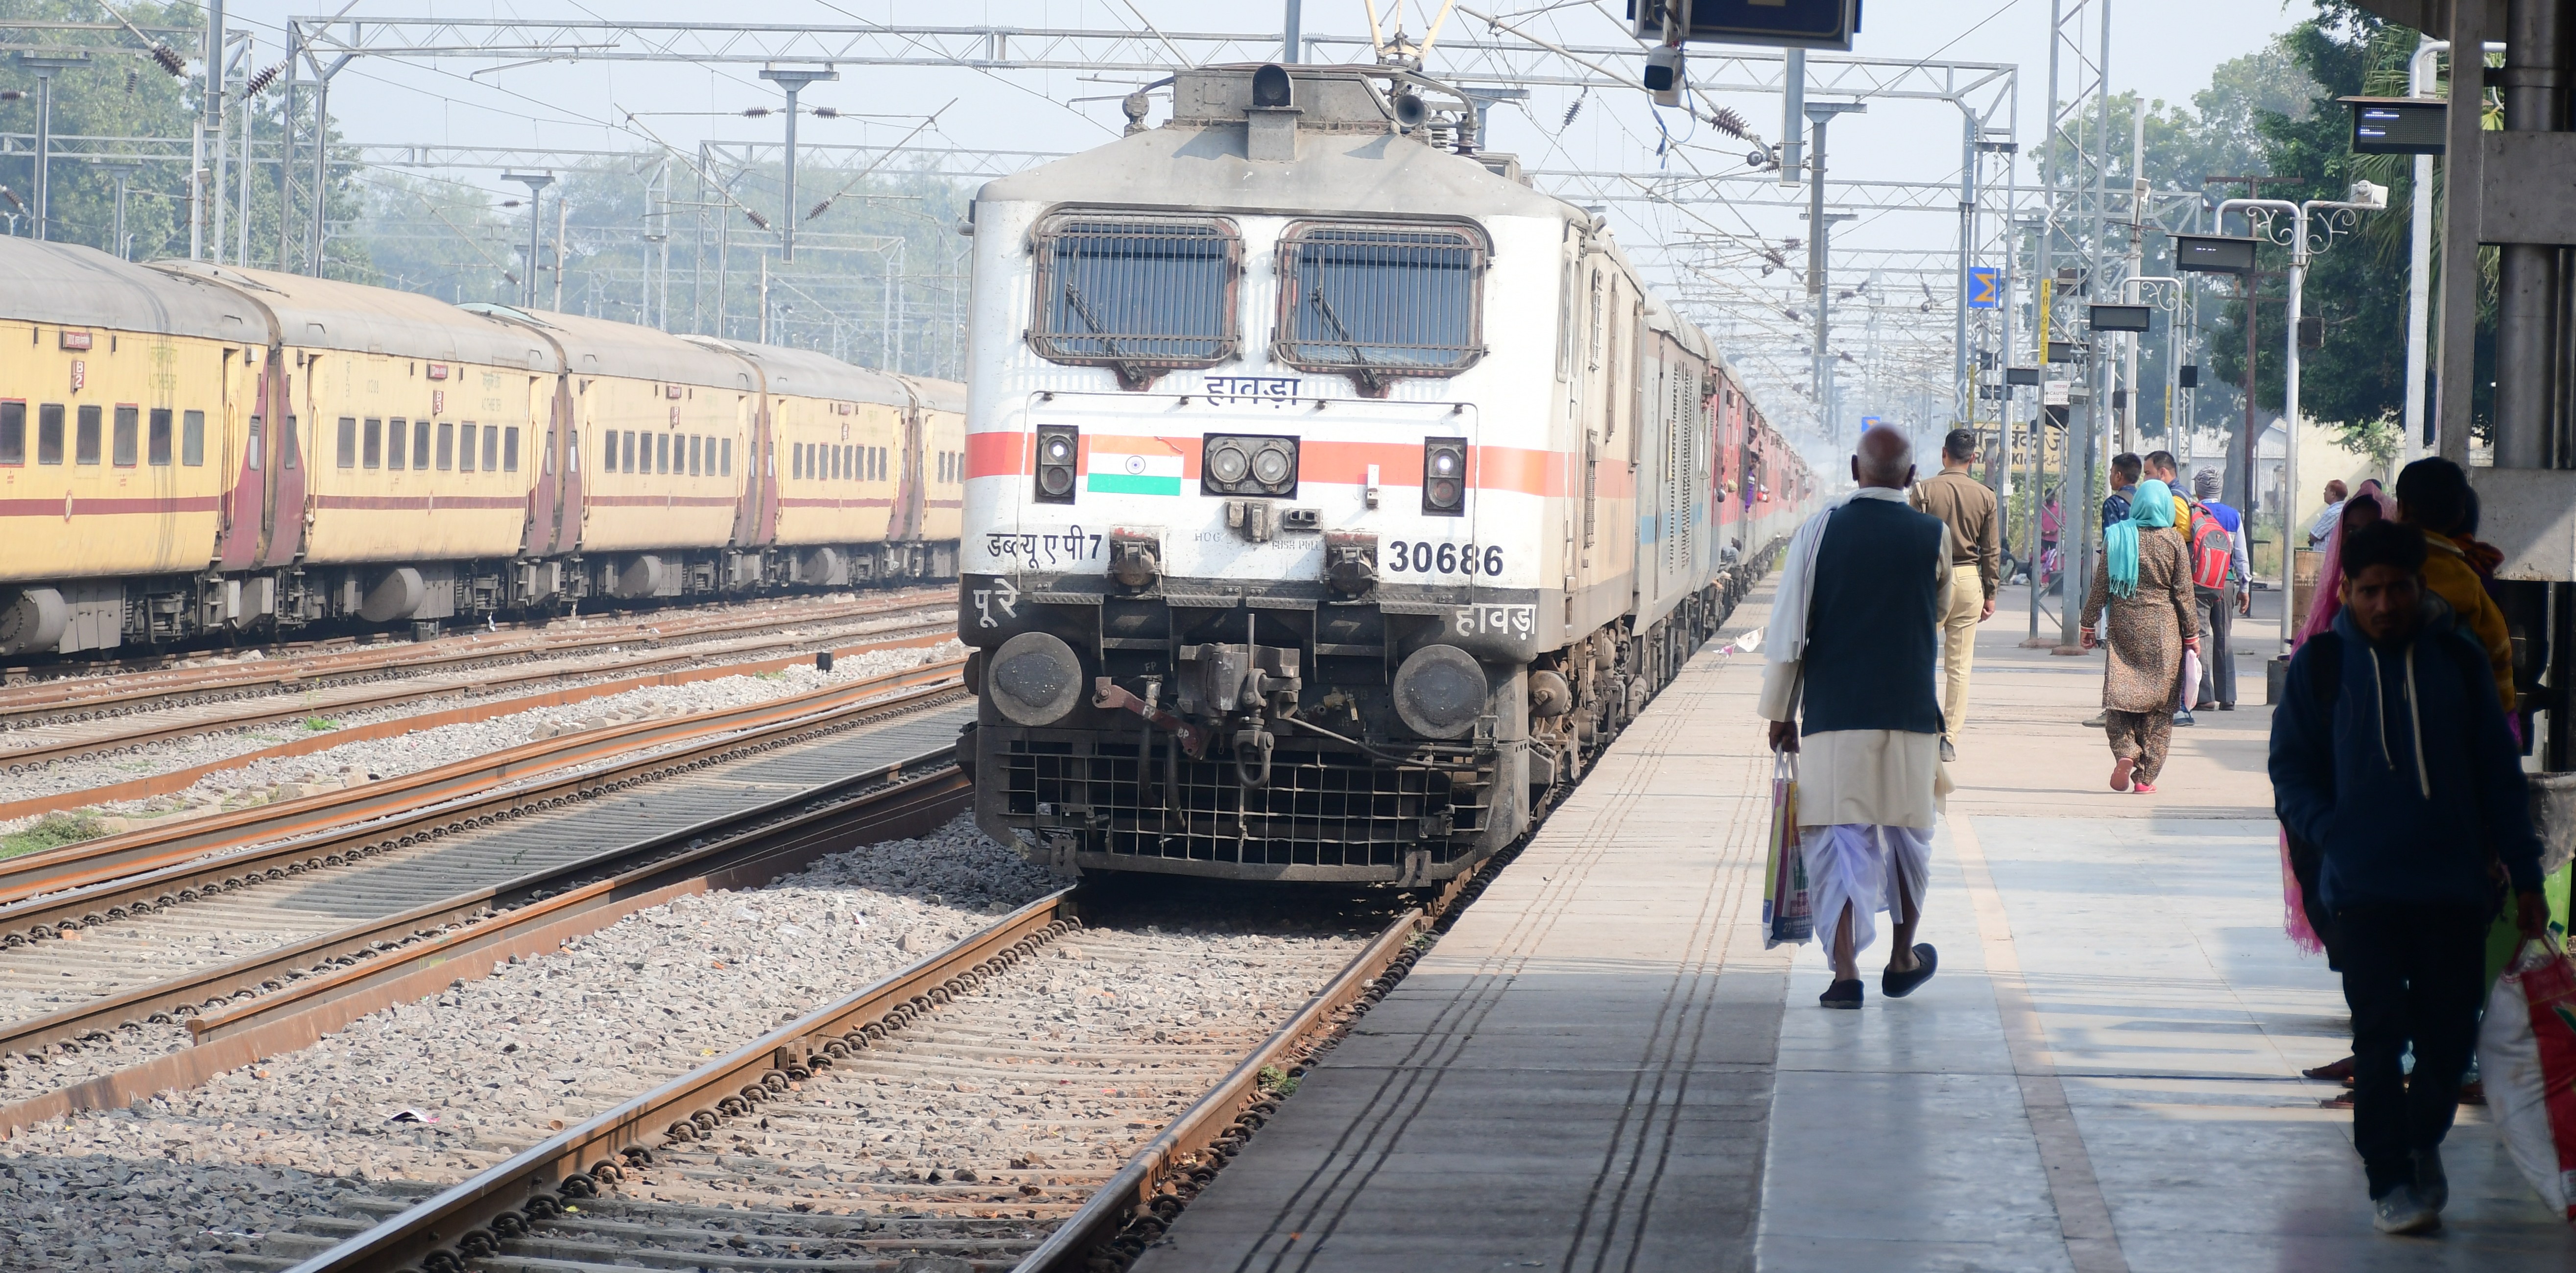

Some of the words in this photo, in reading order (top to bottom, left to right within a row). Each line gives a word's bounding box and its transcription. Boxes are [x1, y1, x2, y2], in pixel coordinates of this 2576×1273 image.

[1204, 376, 1301, 408] हावड़ा
[986, 533, 1039, 569] डब्ल्यू
[1043, 535, 1059, 565] ए
[1090, 534, 1102, 559] 7
[1195, 532, 1221, 542] HOG
[1298, 540, 1322, 551] PULL
[1389, 541, 1503, 576] 30686
[1455, 603, 1537, 640] हावड़ा
[1145, 662, 1156, 672] FP
